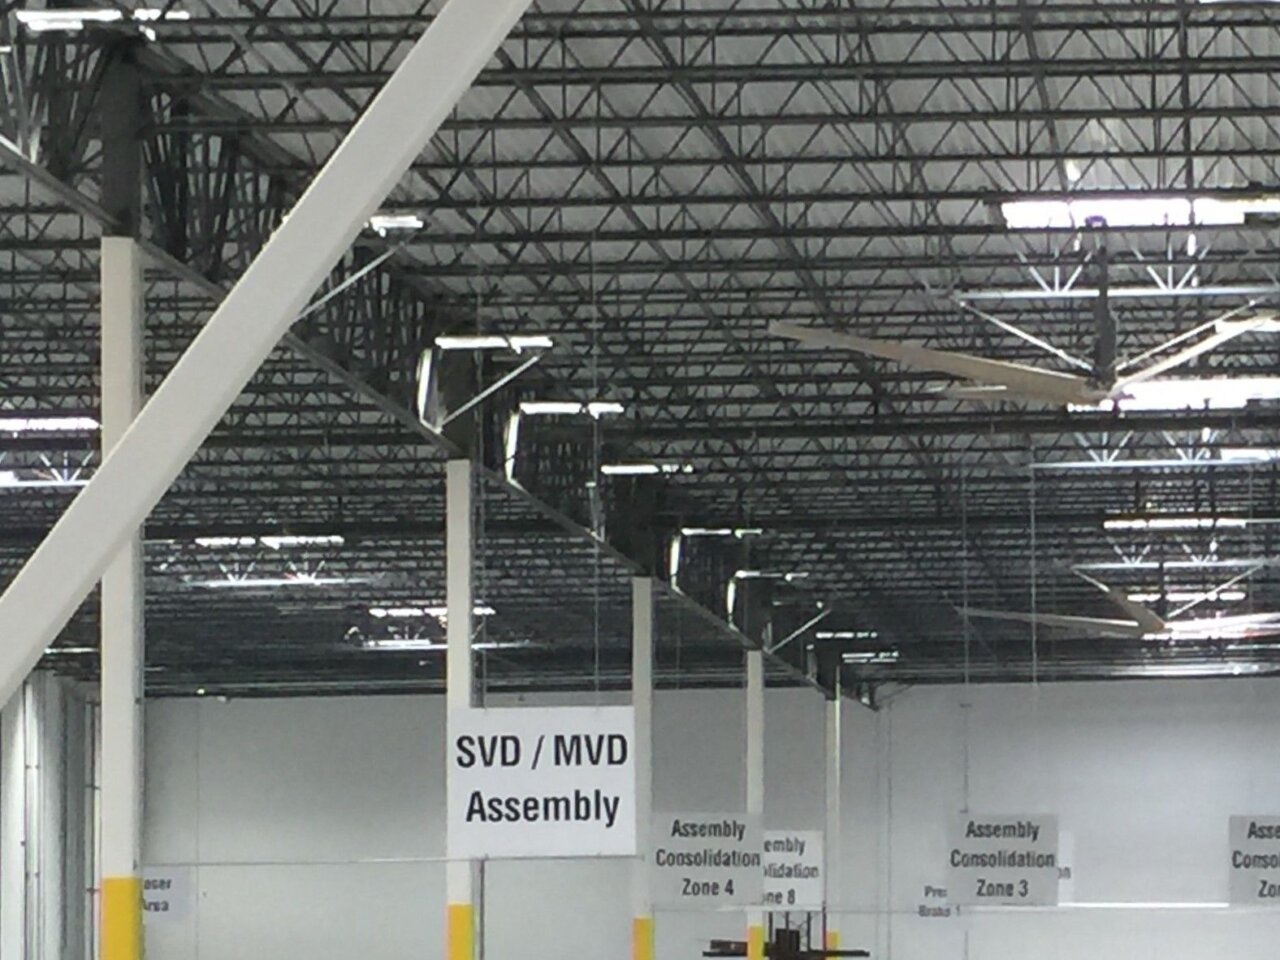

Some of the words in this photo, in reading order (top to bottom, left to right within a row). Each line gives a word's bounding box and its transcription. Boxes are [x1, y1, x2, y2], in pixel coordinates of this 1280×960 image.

[456, 734, 521, 768] SVD
[531, 734, 545, 770] /
[553, 733, 629, 767] MVD
[465, 790, 620, 828] Assembly
[671, 819, 746, 841] Assembly
[965, 820, 1040, 842] Assembly
[763, 836, 806, 856] embly
[656, 848, 761, 867] Consolidation
[950, 848, 1055, 868] Consolidation
[143, 879, 172, 890] aser
[682, 878, 719, 896] Zone
[725, 878, 734, 896] 4
[976, 878, 1014, 897] Zone
[1018, 878, 1029, 898] 3
[787, 888, 796, 905] 8
